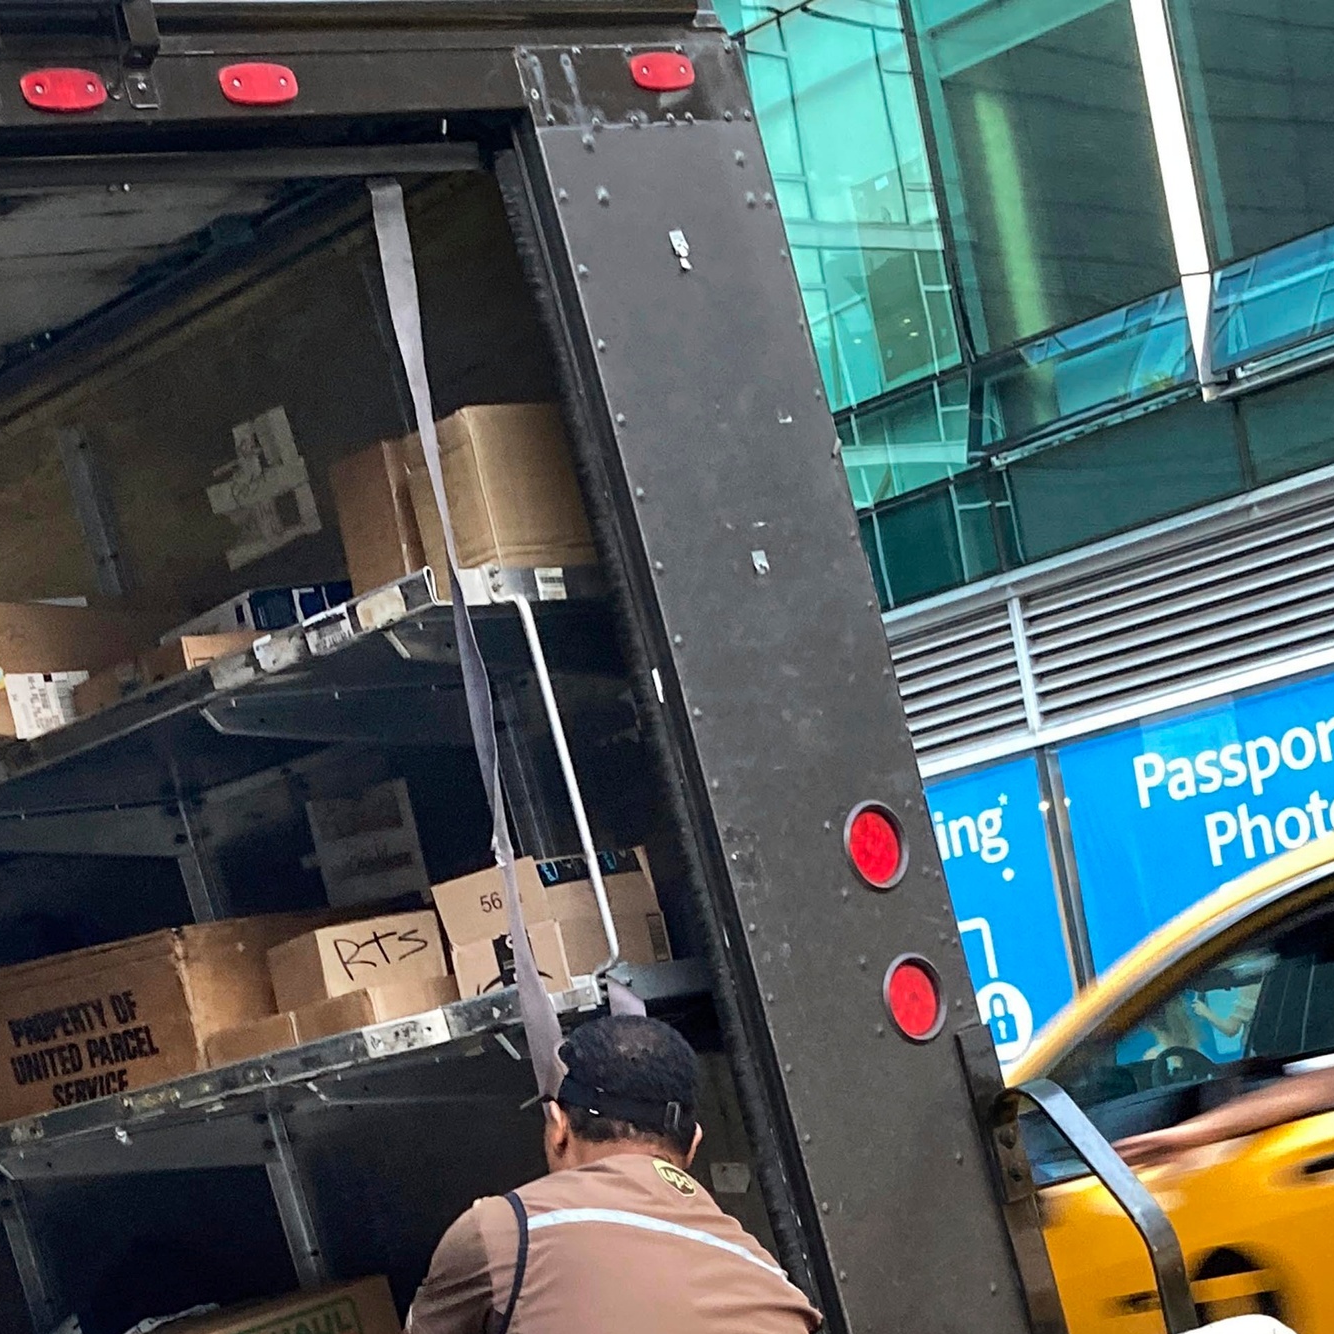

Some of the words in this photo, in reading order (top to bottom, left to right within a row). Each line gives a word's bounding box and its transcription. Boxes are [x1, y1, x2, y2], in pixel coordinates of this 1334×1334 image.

[333, 929, 428, 981] RTS
[8, 1000, 107, 1048] PROPERTY
[110, 990, 137, 1024] OF
[10, 1043, 83, 1085] UNITED
[86, 1025, 160, 1068] PARCEL
[53, 1069, 129, 1108] SERVICE
